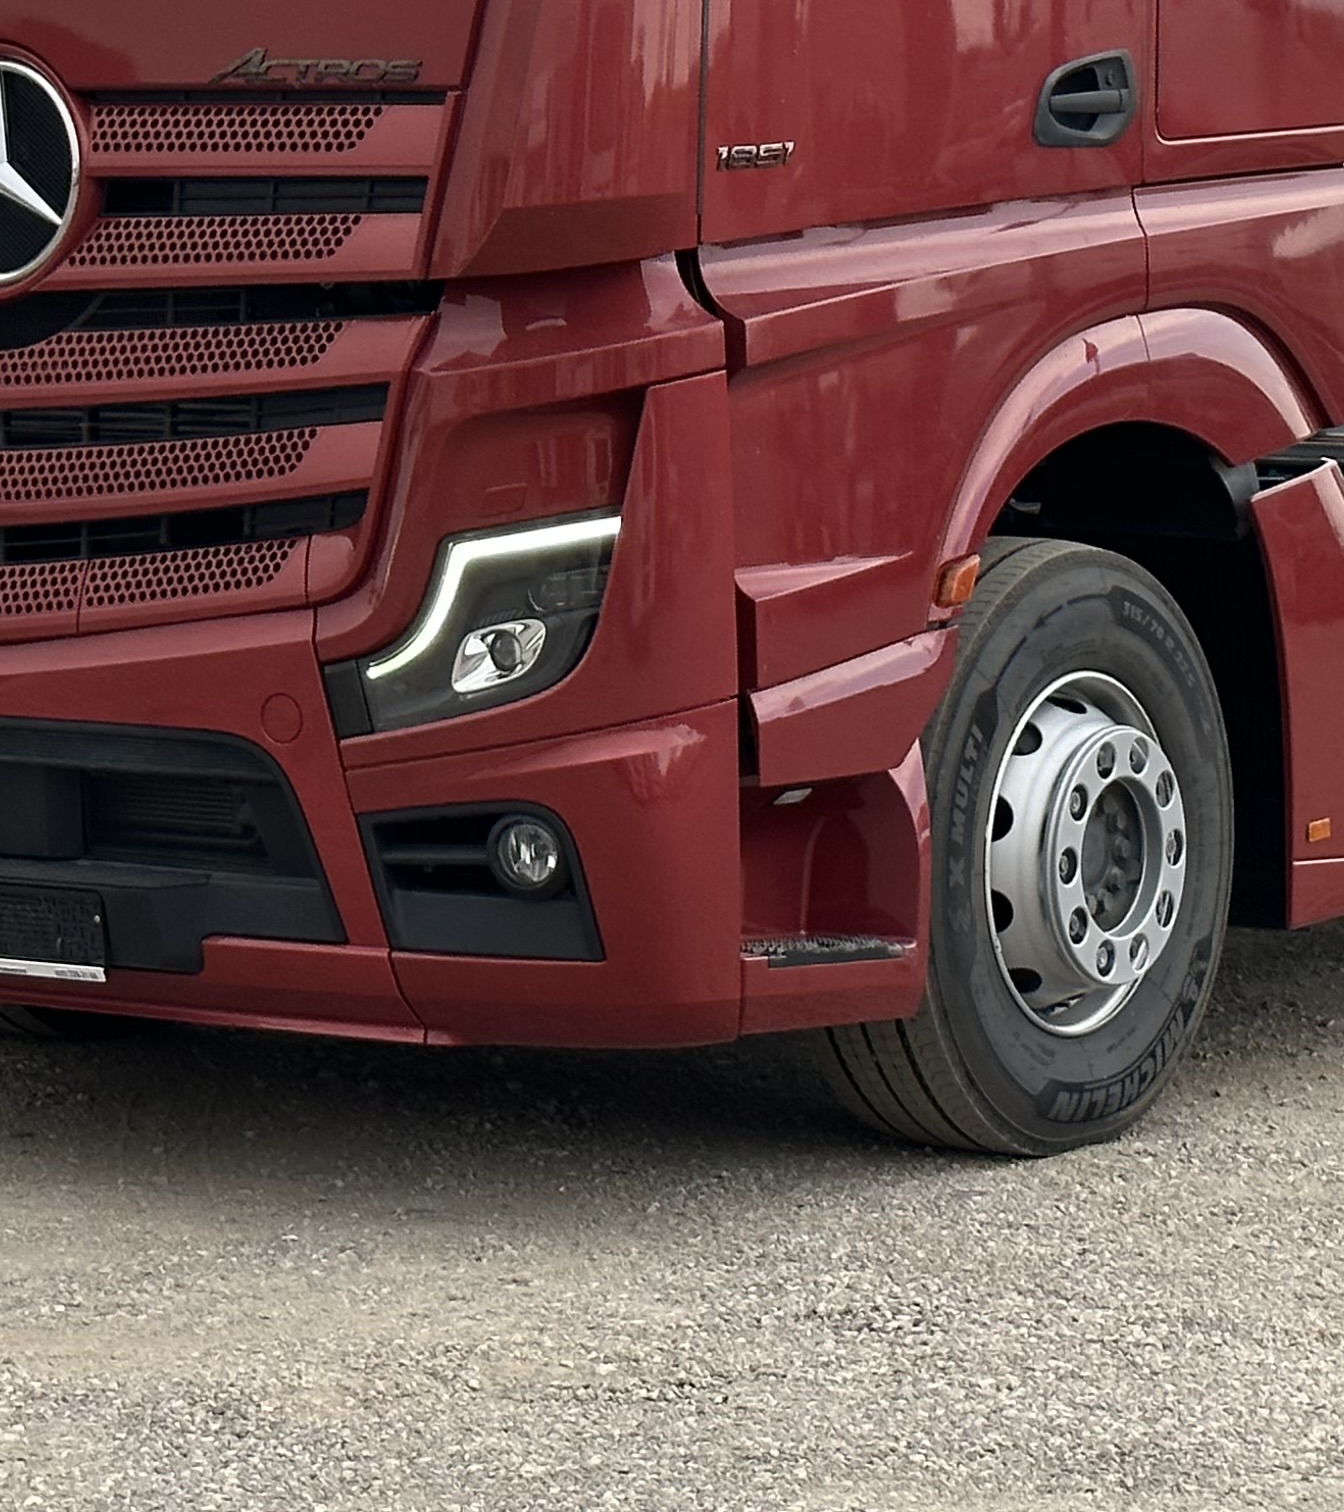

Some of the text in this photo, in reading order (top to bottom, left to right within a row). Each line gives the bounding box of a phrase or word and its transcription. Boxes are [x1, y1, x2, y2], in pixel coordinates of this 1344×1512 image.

[716, 140, 795, 171] 1851
[950, 723, 984, 845] MULTI
[1047, 1005, 1185, 1122] MICHELIN
